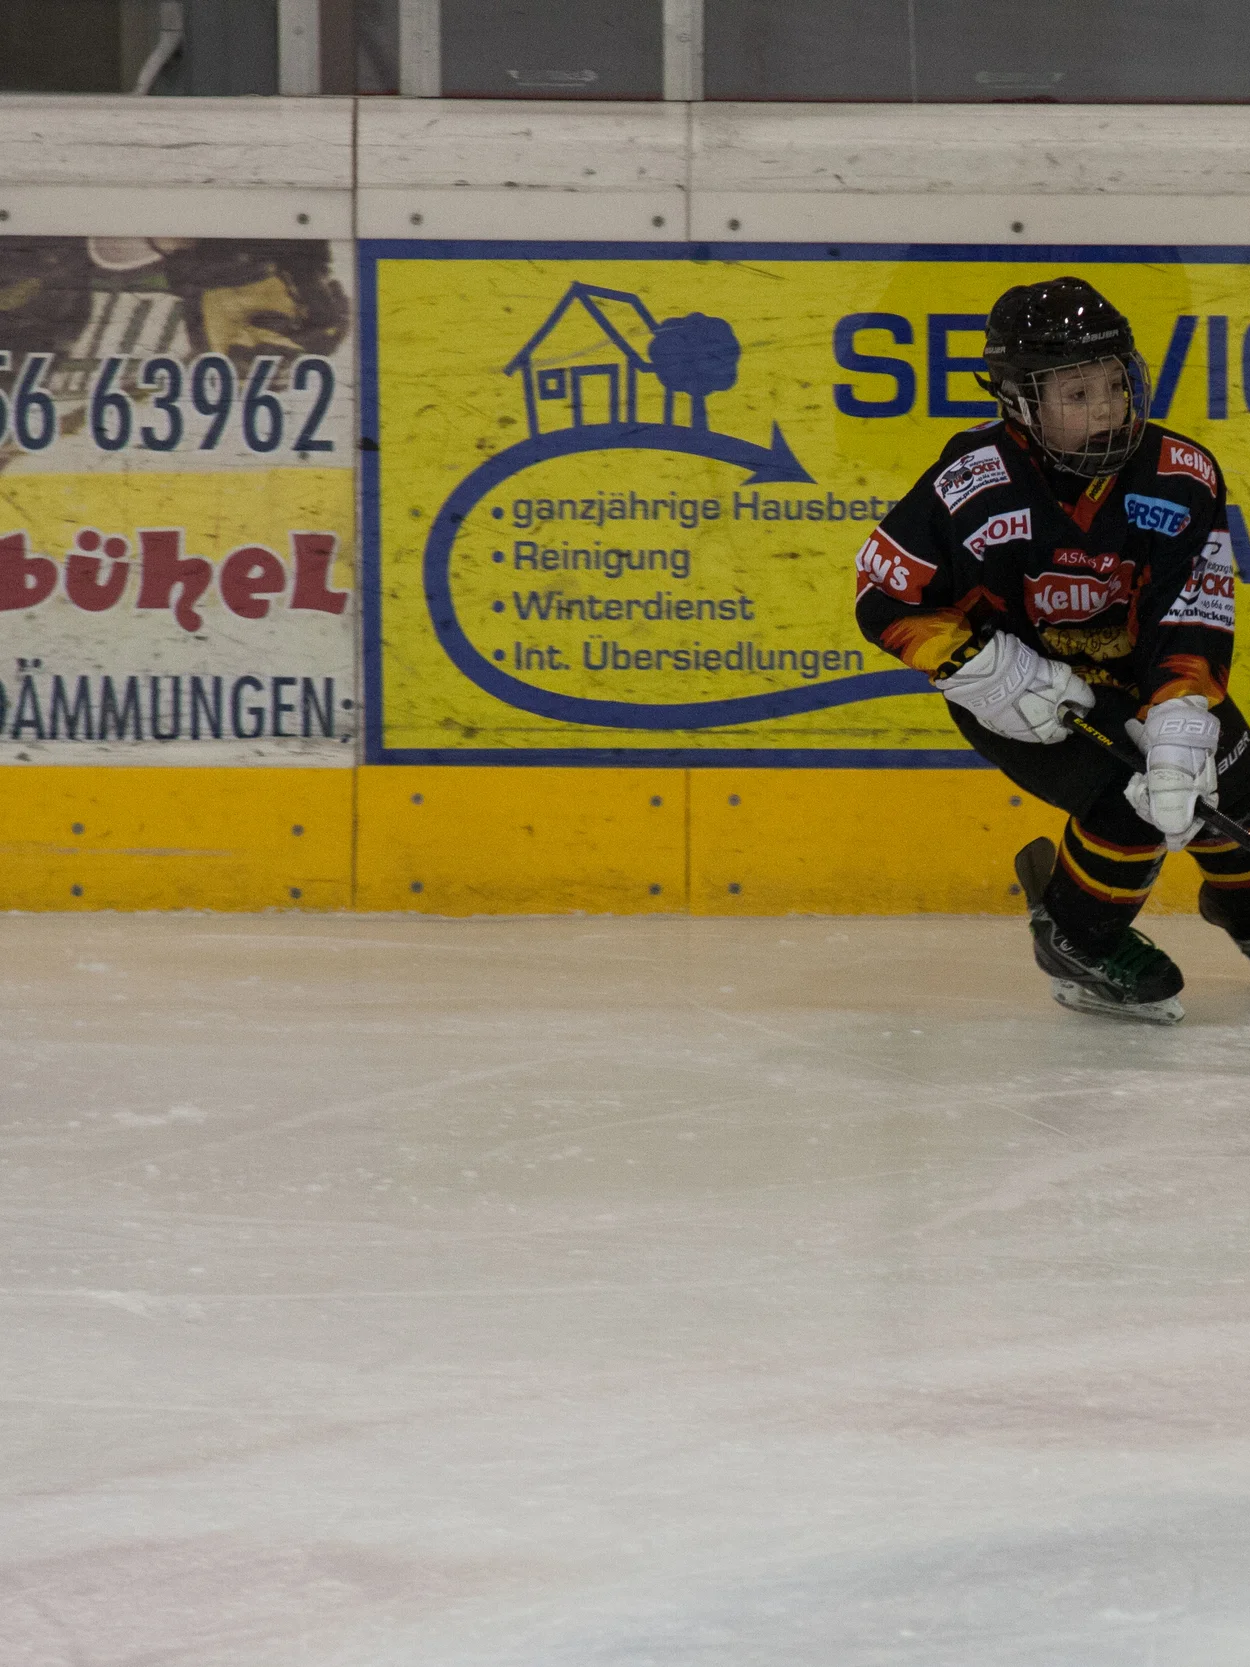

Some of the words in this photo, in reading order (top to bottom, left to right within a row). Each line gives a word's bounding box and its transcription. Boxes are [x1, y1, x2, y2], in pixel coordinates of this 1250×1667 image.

[0, 353, 56, 450] 6
[90, 356, 335, 453] 63962
[1170, 446, 1217, 487] Kelly's
[514, 491, 721, 529] ganzjährige
[515, 541, 691, 578] Reinigung
[856, 538, 910, 592] lly's
[514, 592, 755, 621] Winterdienst
[1034, 575, 1122, 616] Kelly's
[514, 643, 571, 670] Int.
[582, 633, 864, 678] Übersiedlungen
[0, 657, 335, 740] ÄMMUNGEN
[1073, 718, 1114, 747] EASTON
